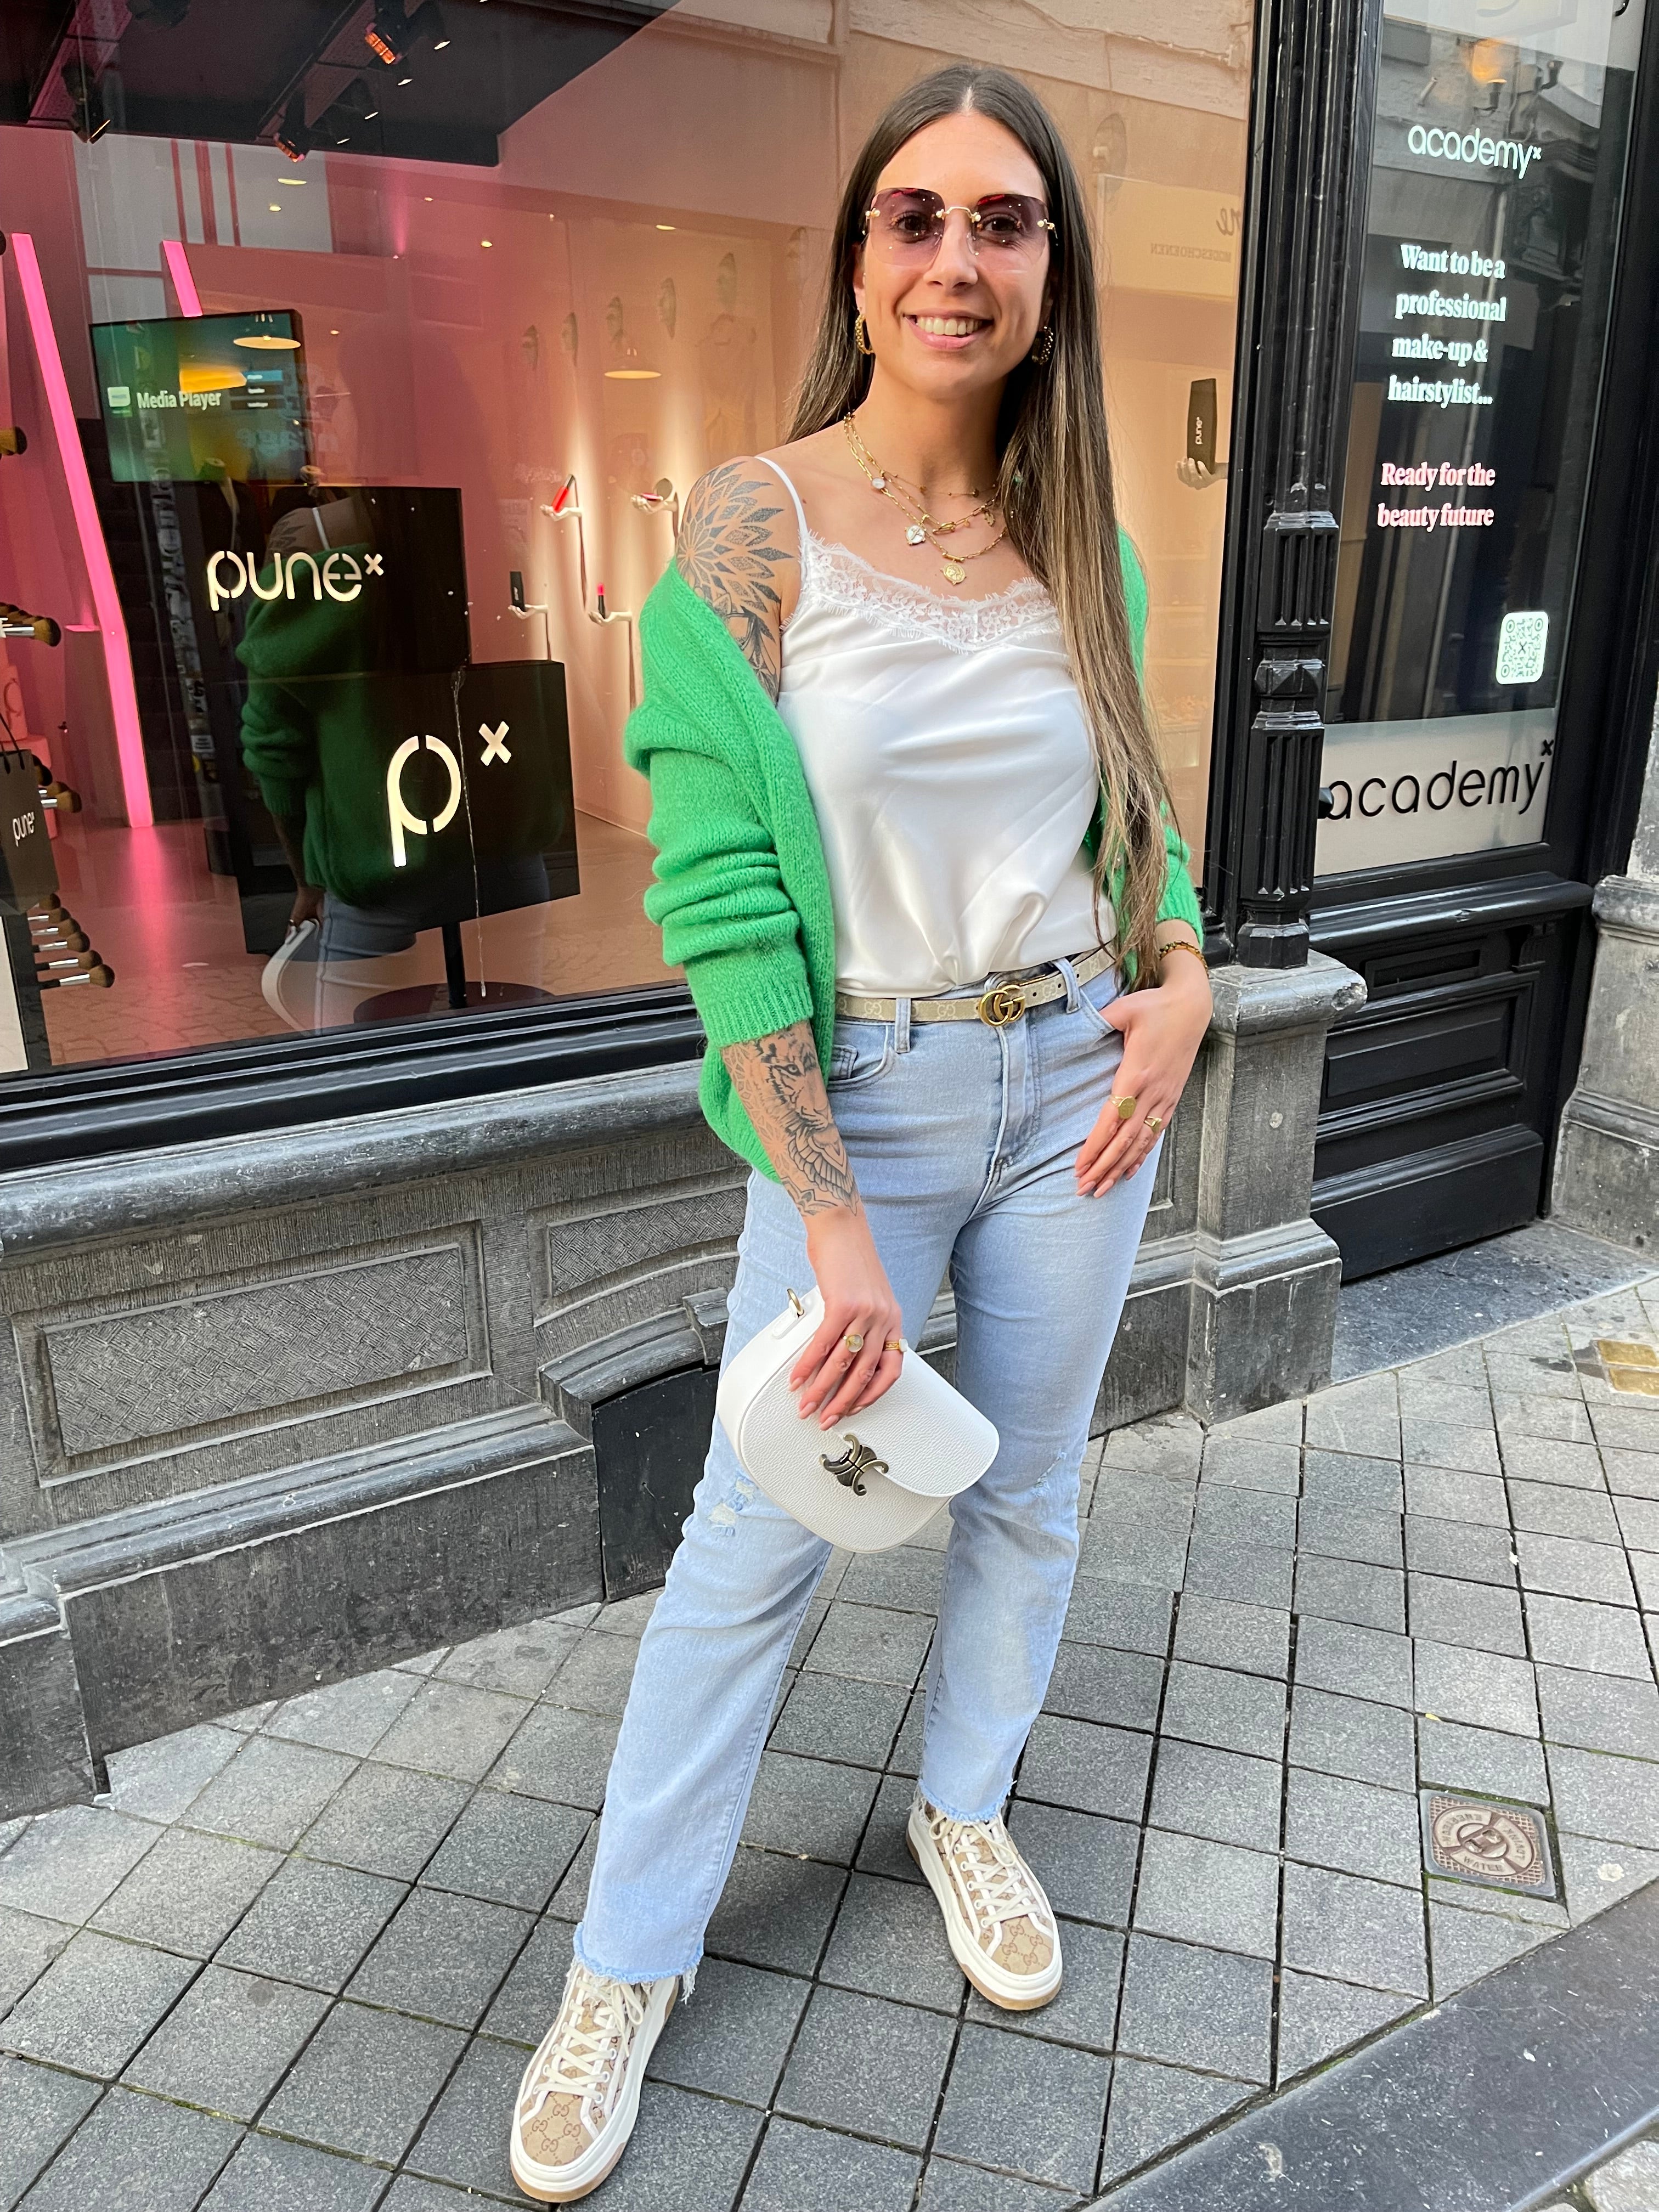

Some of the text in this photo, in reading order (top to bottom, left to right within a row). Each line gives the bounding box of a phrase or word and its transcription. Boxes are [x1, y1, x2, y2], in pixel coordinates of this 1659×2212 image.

[1400, 244, 1505, 279] Want to be a
[1395, 289, 1507, 321] professional
[1391, 333, 1488, 367] make-up &
[137, 389, 221, 411] Media Player
[1380, 461, 1496, 492] Ready for the
[1377, 503, 1494, 532] beauty future
[1463, 1855, 1504, 1872] WATER
